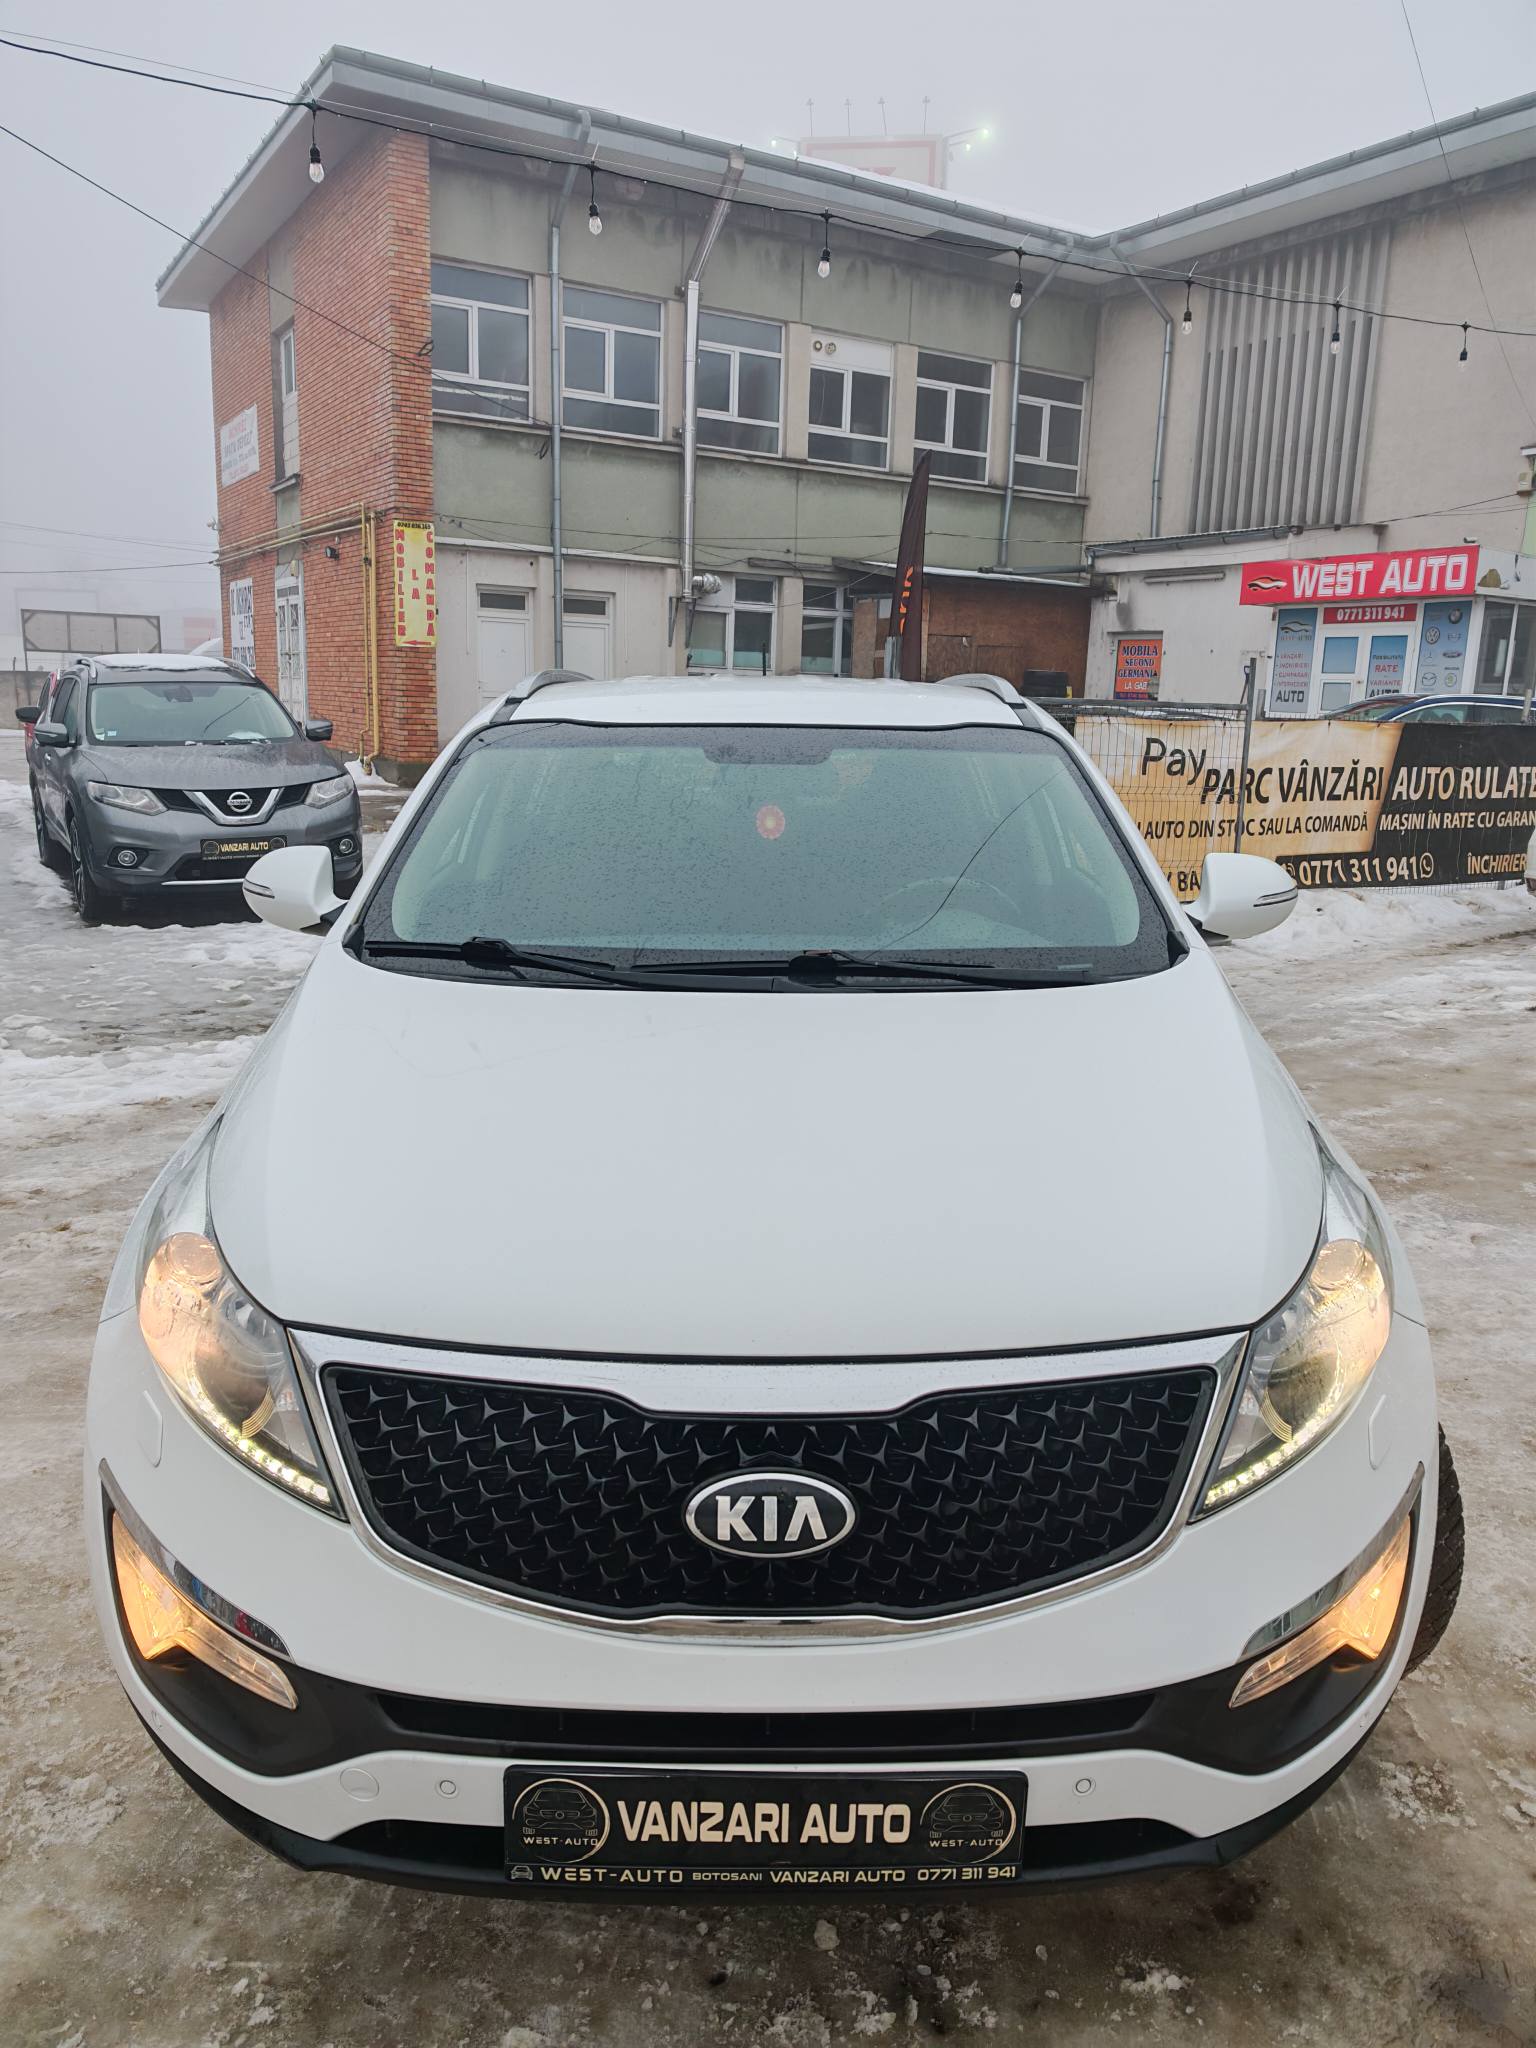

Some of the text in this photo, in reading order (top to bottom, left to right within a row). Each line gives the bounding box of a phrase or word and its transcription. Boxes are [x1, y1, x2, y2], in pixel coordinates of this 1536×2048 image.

[395, 529, 406, 636] MOBILIER
[412, 569, 420, 599] LA
[1292, 554, 1469, 598] WEST AUTO
[1122, 645, 1158, 656] MOBILA
[1118, 669, 1158, 678] GERMANIA
[1125, 659, 1154, 667] SECOND
[1375, 664, 1398, 672] RATE
[1275, 690, 1305, 703] AUTO
[1141, 737, 1207, 786] Pay
[1200, 767, 1273, 805] PARC
[1278, 758, 1385, 803] VÂNZĂRI
[1392, 766, 1455, 801] AUTO
[1144, 820, 1185, 840] AUTO
[1188, 819, 1215, 838] DIN
[1258, 818, 1284, 836] SAU
[1286, 816, 1302, 834] LA
[1305, 811, 1368, 833] COMANDĂ
[1427, 810, 1440, 829] ÎN
[1443, 811, 1475, 829] RATE
[1477, 811, 1495, 828] CU
[220, 841, 269, 852] VANZARI AUTO
[1299, 856, 1418, 886] 0771 311 941
[715, 1495, 828, 1542] KIA
[616, 1800, 912, 1844] VANZARI AUTO
[523, 1836, 600, 1846] WEST-AUTO
[929, 1838, 1004, 1848] WEST-AUTO
[540, 1865, 1016, 1884] WEST-AUTO BOTOSANI VANZARI AUTO 0771 311 941
